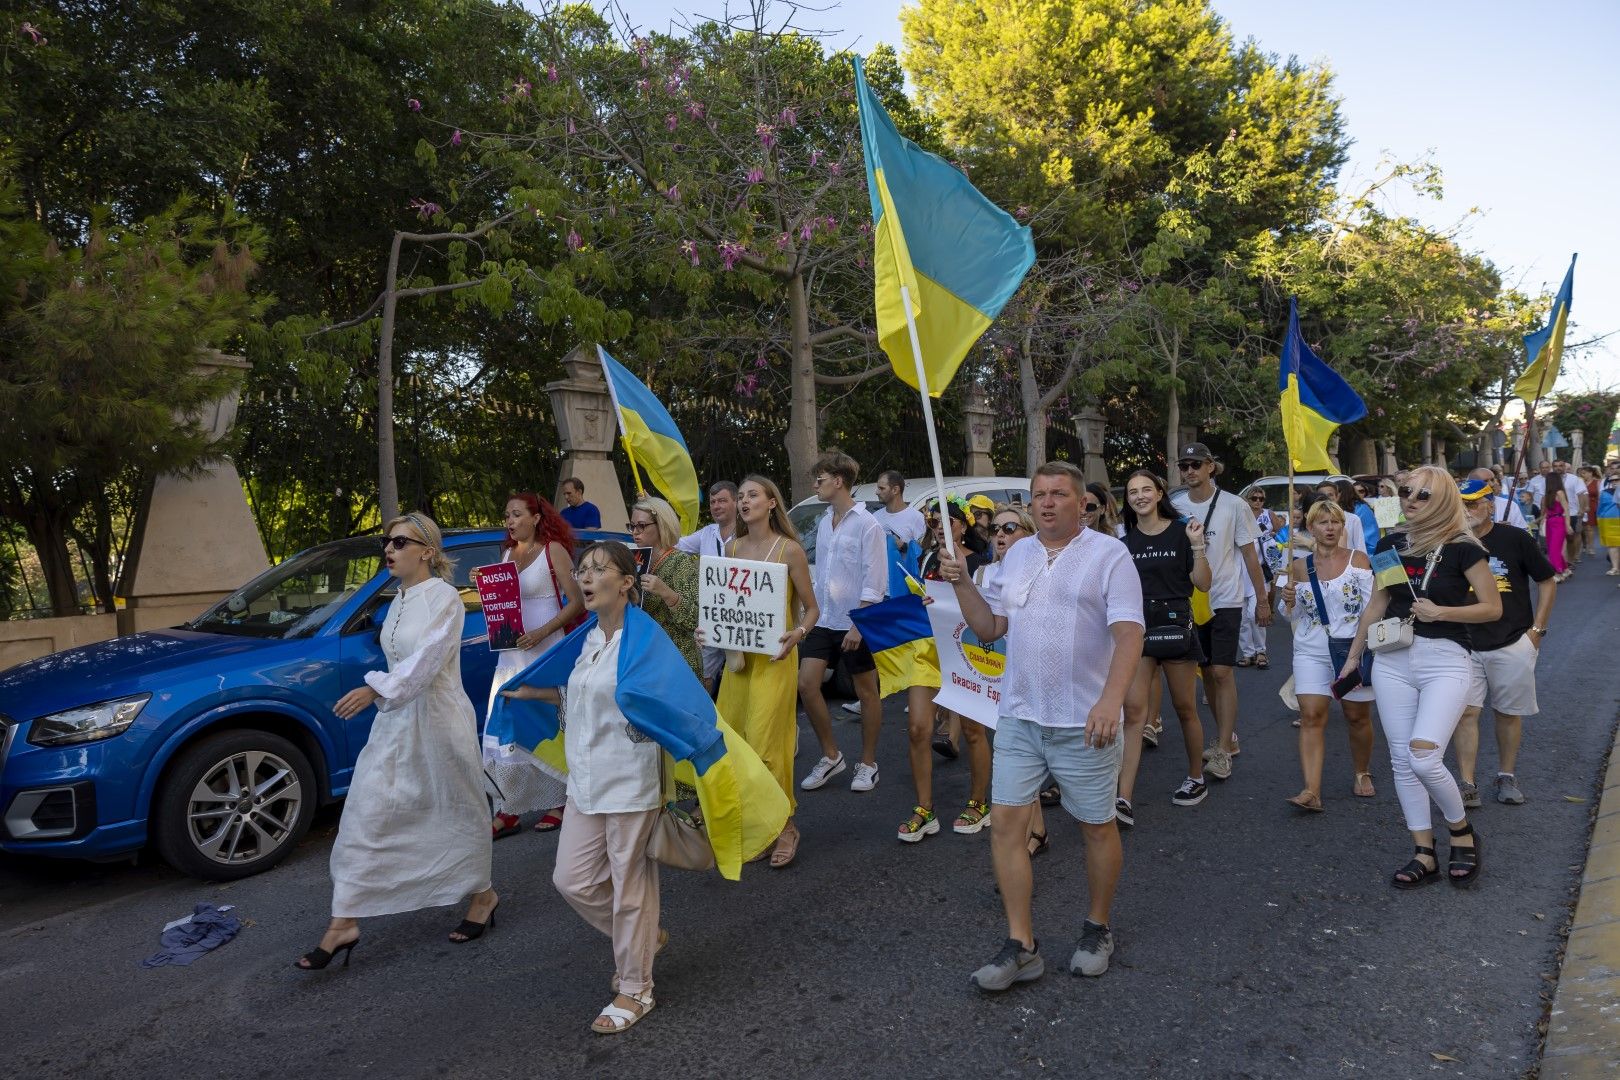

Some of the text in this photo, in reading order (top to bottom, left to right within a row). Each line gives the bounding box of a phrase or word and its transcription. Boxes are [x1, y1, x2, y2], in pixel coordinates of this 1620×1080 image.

[482, 571, 513, 585] RUSSIA
[705, 565, 774, 597] RUZZIA
[481, 592, 497, 601] LIES
[713, 592, 746, 607] IS A
[484, 600, 518, 611] TORTURES
[486, 613, 505, 622] KILLS
[702, 605, 775, 628] TERRORIST
[712, 623, 766, 648] STATE
